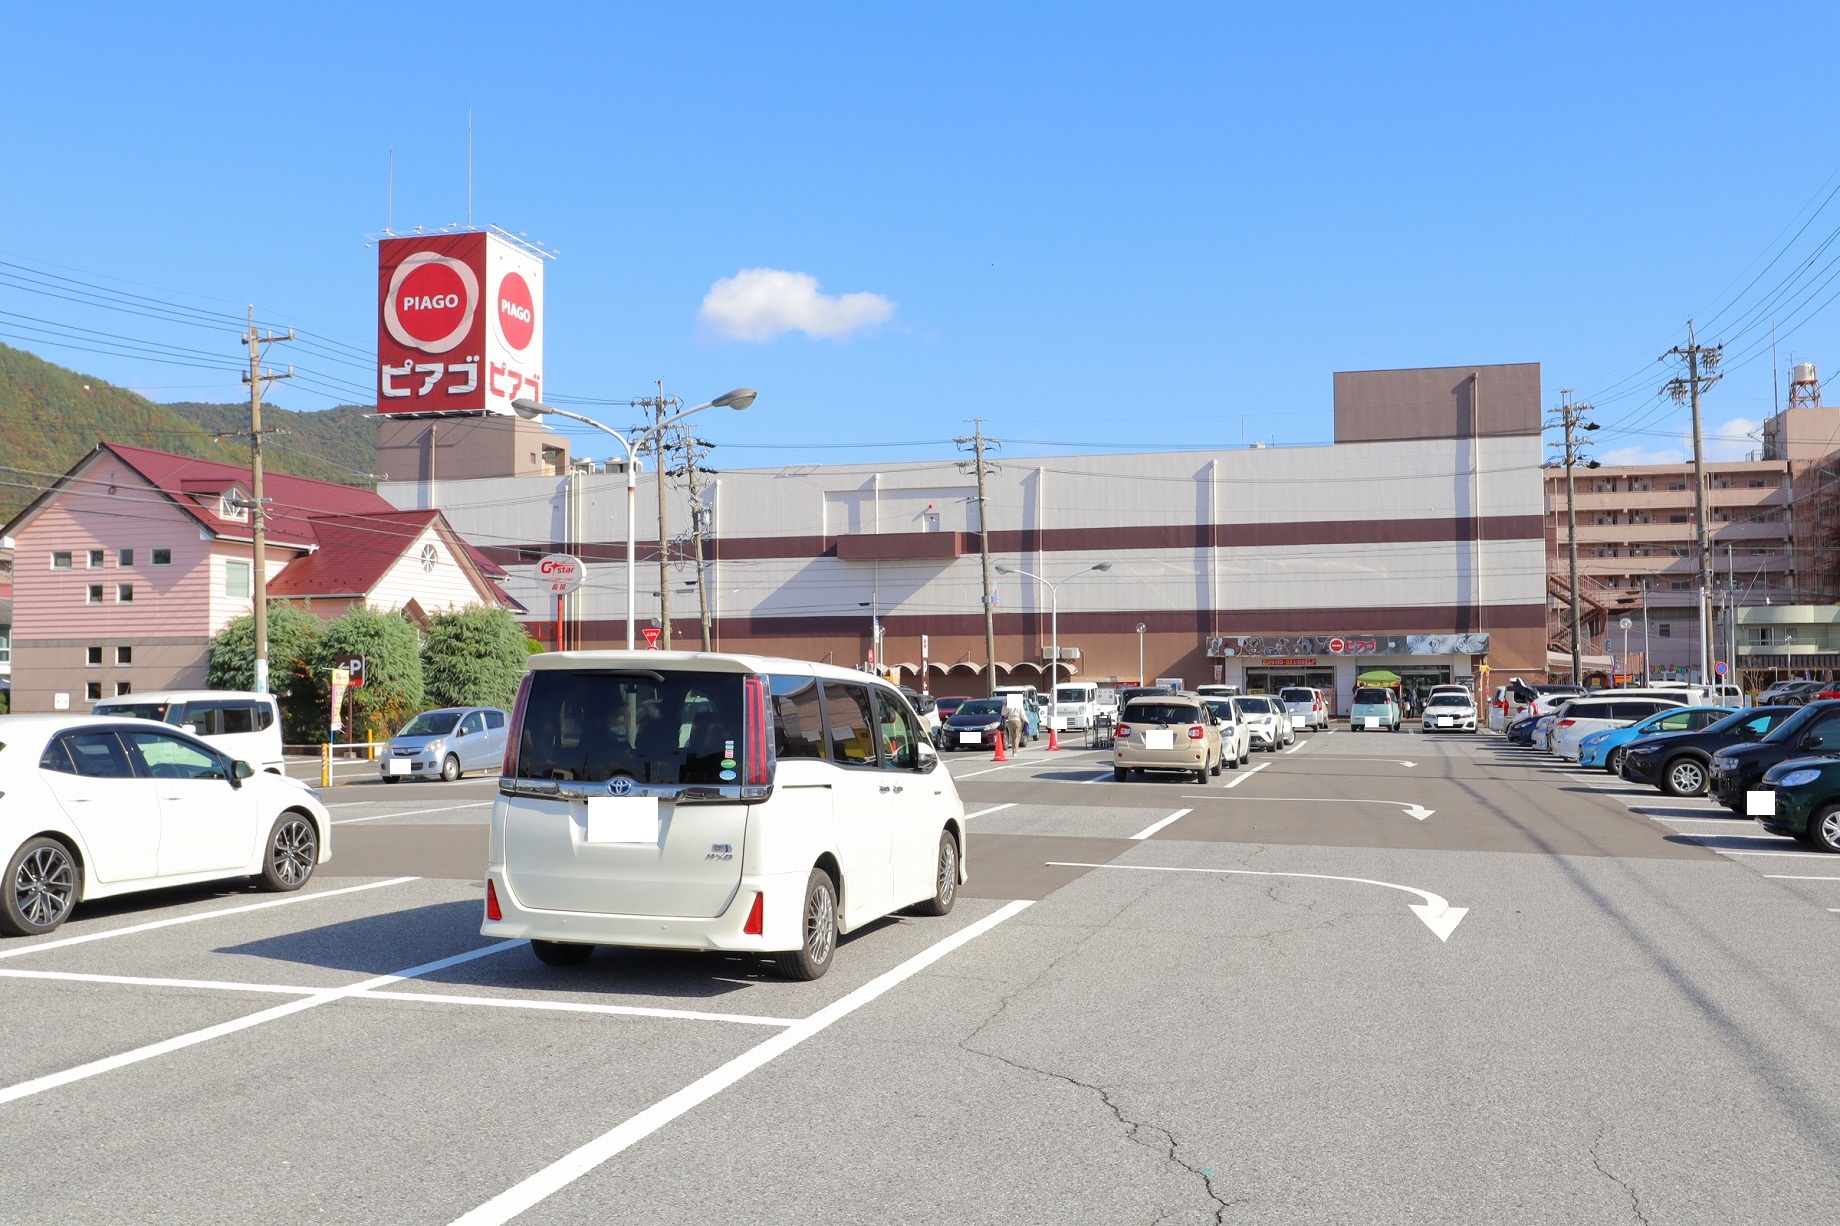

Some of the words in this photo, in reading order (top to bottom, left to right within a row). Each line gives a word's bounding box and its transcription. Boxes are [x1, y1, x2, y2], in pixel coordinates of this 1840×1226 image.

[403, 294, 459, 311] PIAGO
[501, 299, 531, 323] PIAGO
[382, 355, 480, 397] ピアゴ
[489, 361, 540, 403] ピアゴ
[350, 659, 362, 676] P
